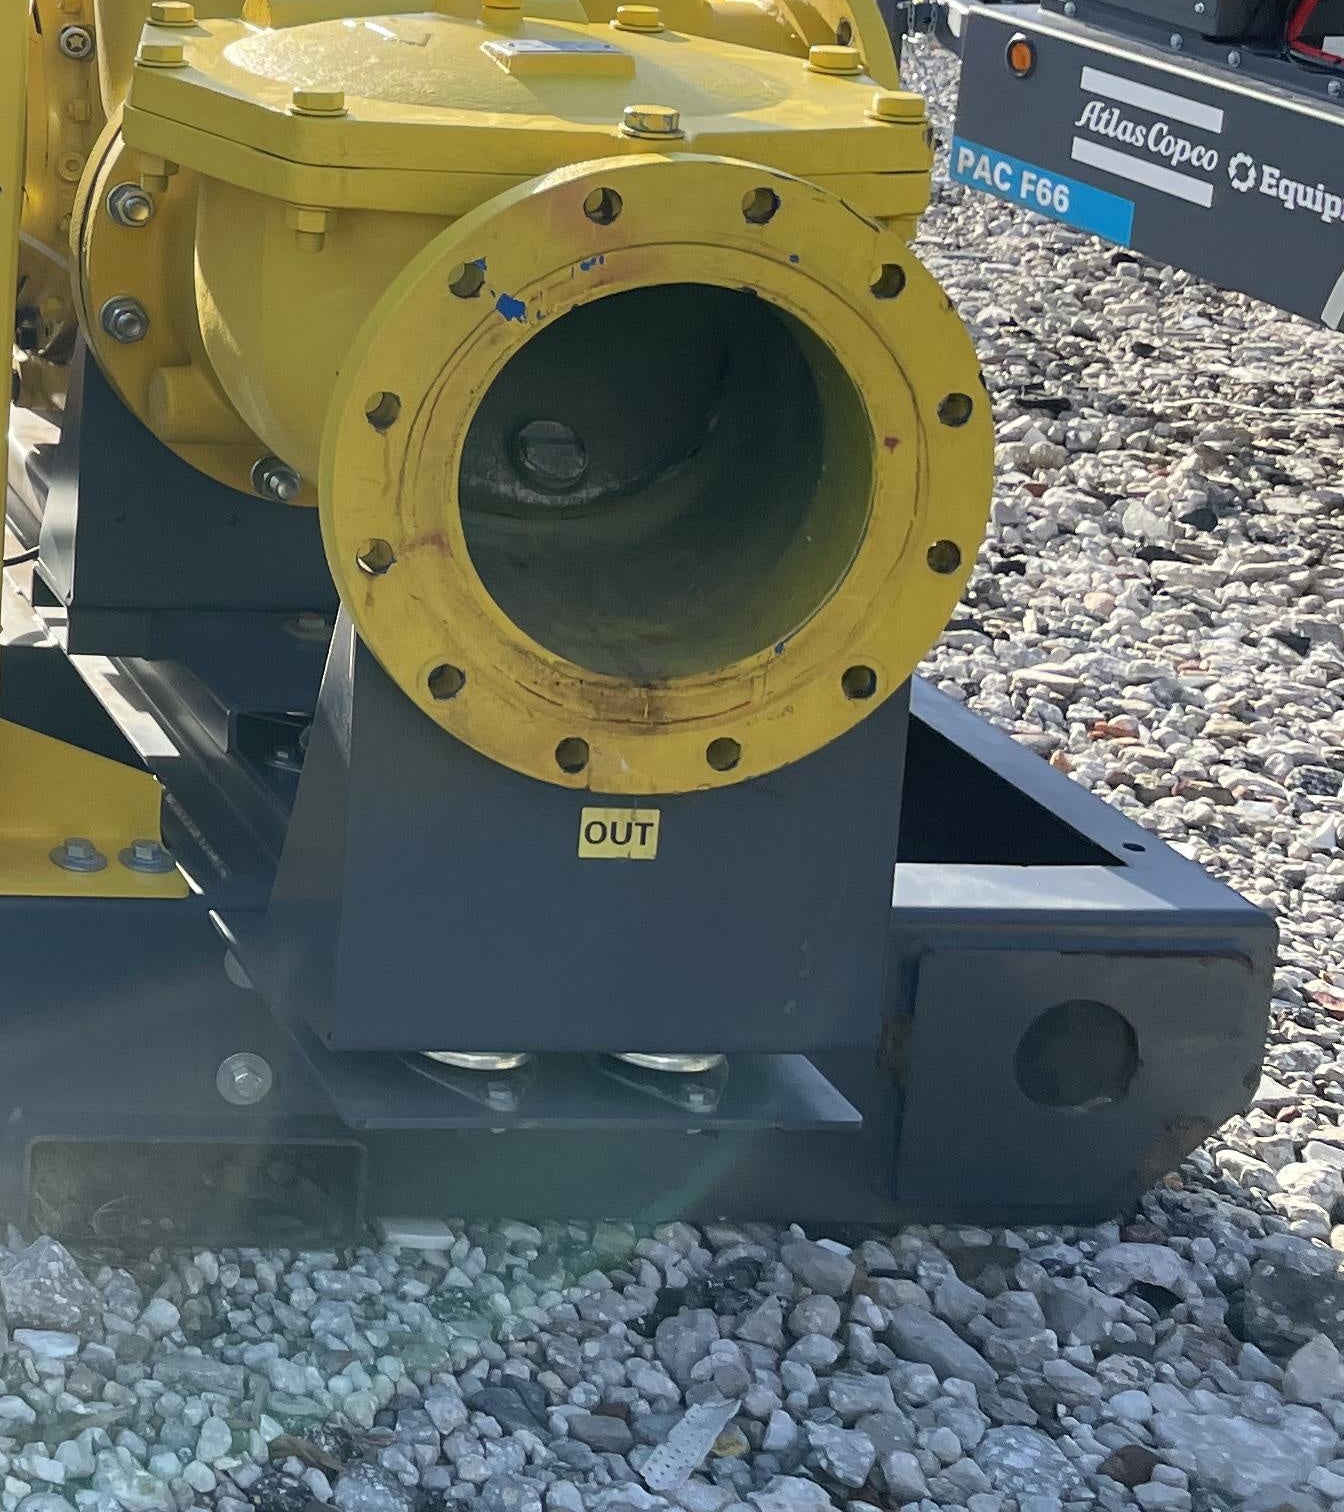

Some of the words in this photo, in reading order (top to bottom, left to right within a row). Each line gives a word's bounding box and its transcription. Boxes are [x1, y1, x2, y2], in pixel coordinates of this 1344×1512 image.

[1074, 99, 1146, 146] Atlas
[1147, 120, 1219, 172] Copco
[957, 147, 1012, 192] PAC
[1020, 170, 1070, 213] F66
[1259, 164, 1344, 224] Equip
[584, 820, 654, 846] OUT
